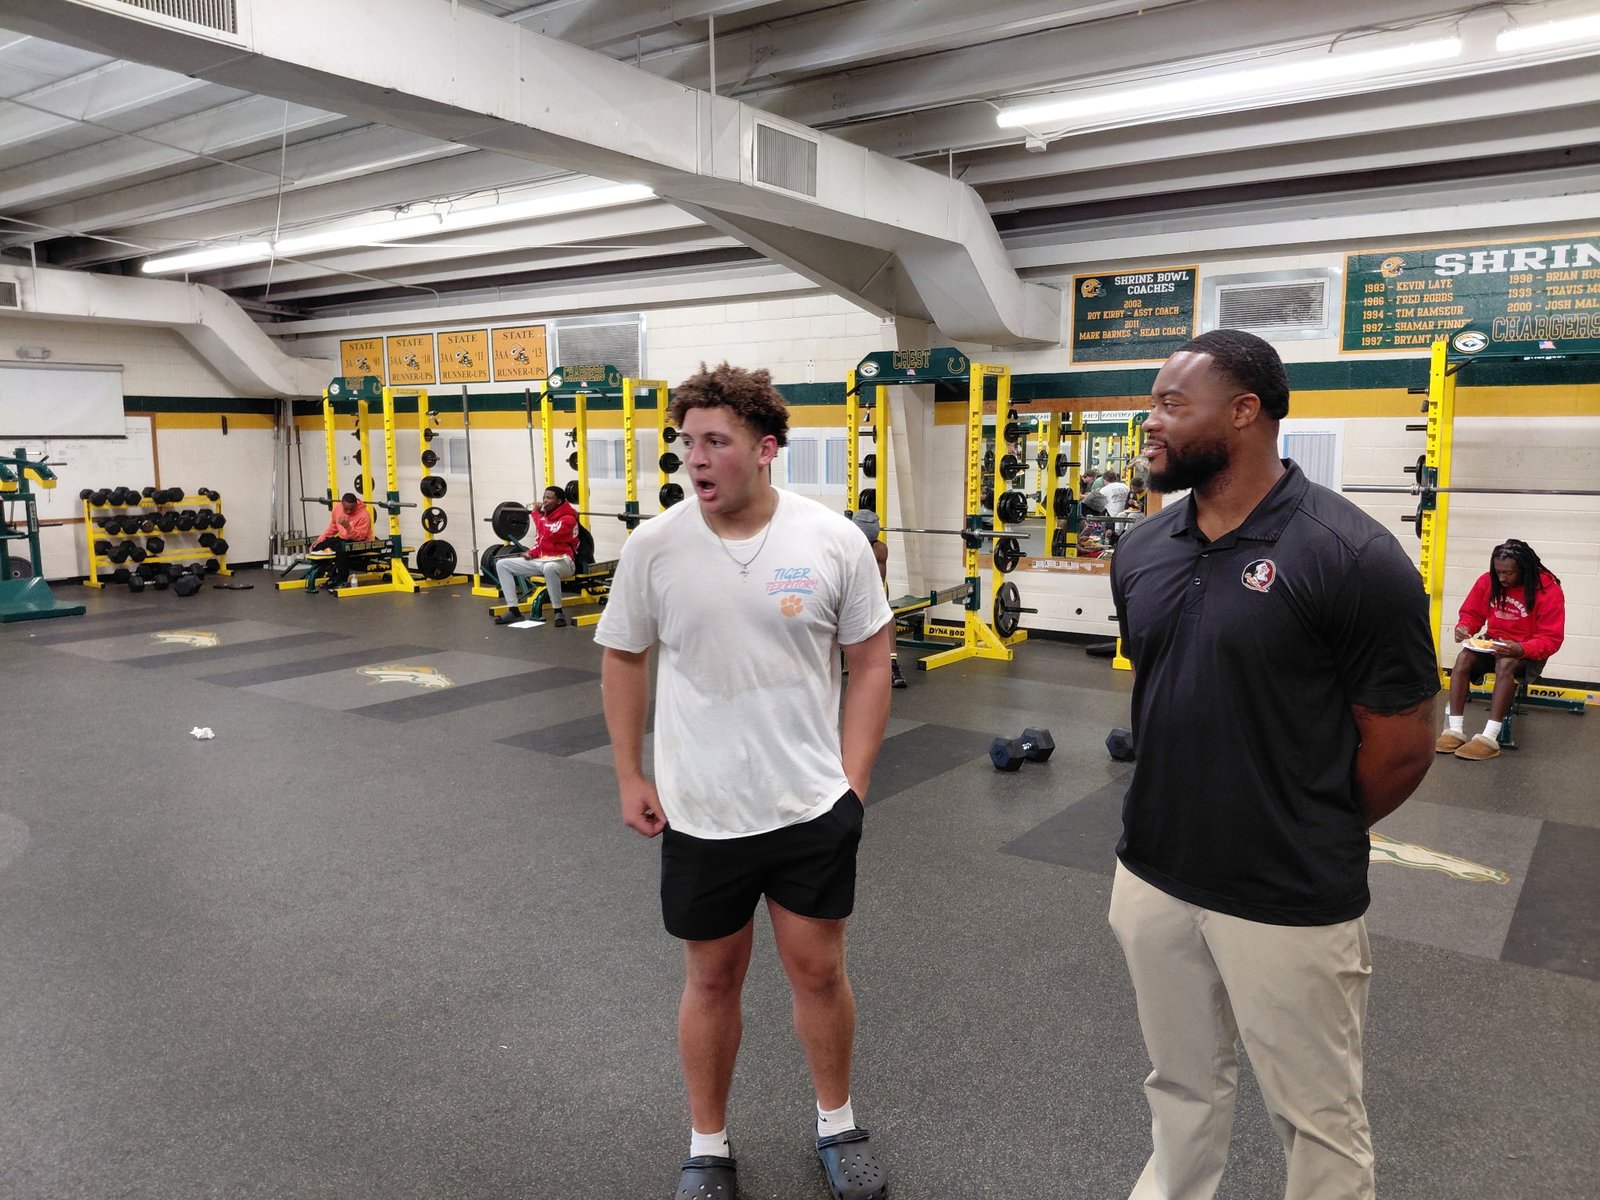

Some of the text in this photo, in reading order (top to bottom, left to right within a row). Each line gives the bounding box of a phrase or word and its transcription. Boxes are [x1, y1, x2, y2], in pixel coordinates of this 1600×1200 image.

[1435, 243, 1600, 276] SHRIN
[1114, 271, 1189, 285] SHRINE BOWL
[1509, 274, 1532, 284] 1998
[1546, 270, 1578, 282] BRIAN
[1127, 283, 1175, 295] COACHES
[1364, 283, 1385, 293] 1983
[1396, 280, 1425, 291] KEVIN
[1428, 279, 1453, 289] LAYE
[1508, 288, 1532, 298] 1999
[1546, 284, 1583, 296] TRAVIS
[1123, 300, 1142, 308] 2002
[1396, 294, 1420, 304] FRED
[1507, 302, 1532, 312] 2000
[1545, 299, 1571, 310] JOSH
[1087, 311, 1101, 320] ROY
[1103, 310, 1124, 319] KIRBY
[1133, 308, 1152, 317] ASST
[1155, 306, 1179, 316] COACH
[1363, 310, 1384, 319] 1994
[1396, 307, 1415, 318] TIM
[1417, 305, 1464, 317] RAMSEUR
[1124, 320, 1140, 328] 2011
[1362, 323, 1383, 333] 1997
[1395, 320, 1435, 331] SHAMAR
[1492, 312, 1600, 342] CHARGERS
[448, 334, 477, 344] STATE
[502, 330, 535, 340] STATE
[1079, 331, 1100, 340] MARK
[1102, 329, 1131, 339] BARNES
[1140, 328, 1160, 337] HEAD
[1162, 326, 1186, 336] COACH
[349, 342, 375, 350] STATE
[396, 338, 424, 347] STATE
[1361, 336, 1383, 346] 1997
[1393, 334, 1431, 345] BRYANT
[494, 350, 509, 360] 3AA
[892, 349, 932, 369] CREST
[392, 372, 433, 381] RUNNER-UPS
[443, 369, 487, 379] RUNNER-UPS
[497, 366, 545, 377] RUNNER-UPS
[774, 567, 811, 581] TIGER
[766, 578, 817, 591] TERRITORY
[928, 627, 948, 635] DYNA
[1530, 688, 1566, 698] BODY
